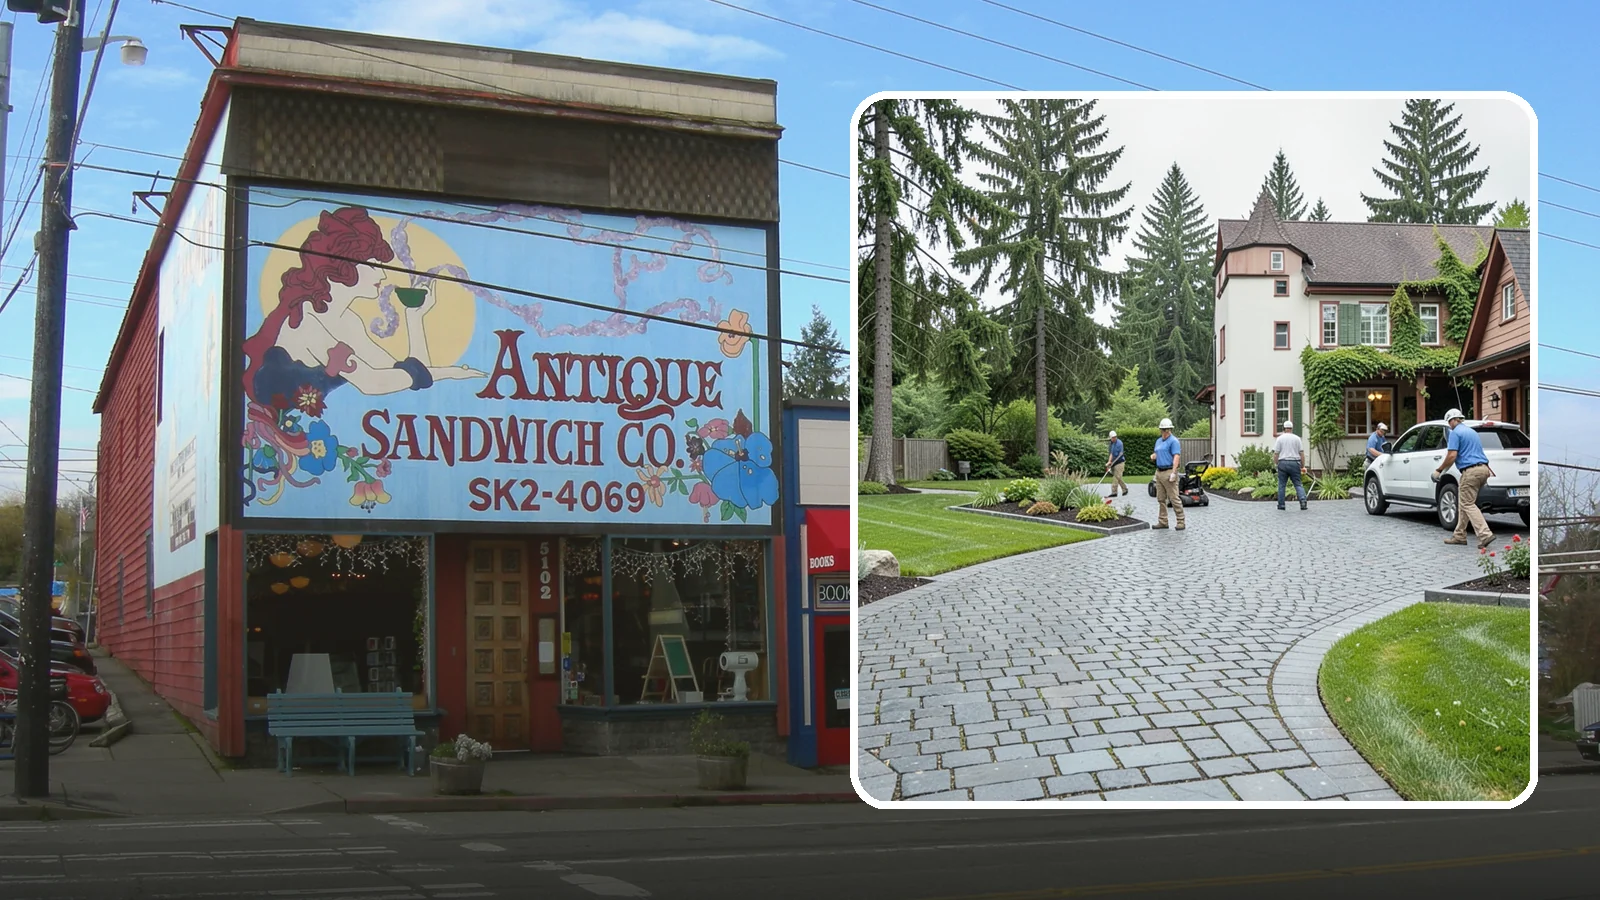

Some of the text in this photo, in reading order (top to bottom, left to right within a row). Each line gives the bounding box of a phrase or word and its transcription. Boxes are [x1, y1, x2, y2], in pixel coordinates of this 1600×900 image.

[476, 329, 724, 421] ANTIQUE
[360, 408, 686, 469] SANDWICH CO.
[468, 476, 647, 513] SK2-4069
[540, 541, 552, 600] 5102
[809, 554, 835, 569] BOOKS
